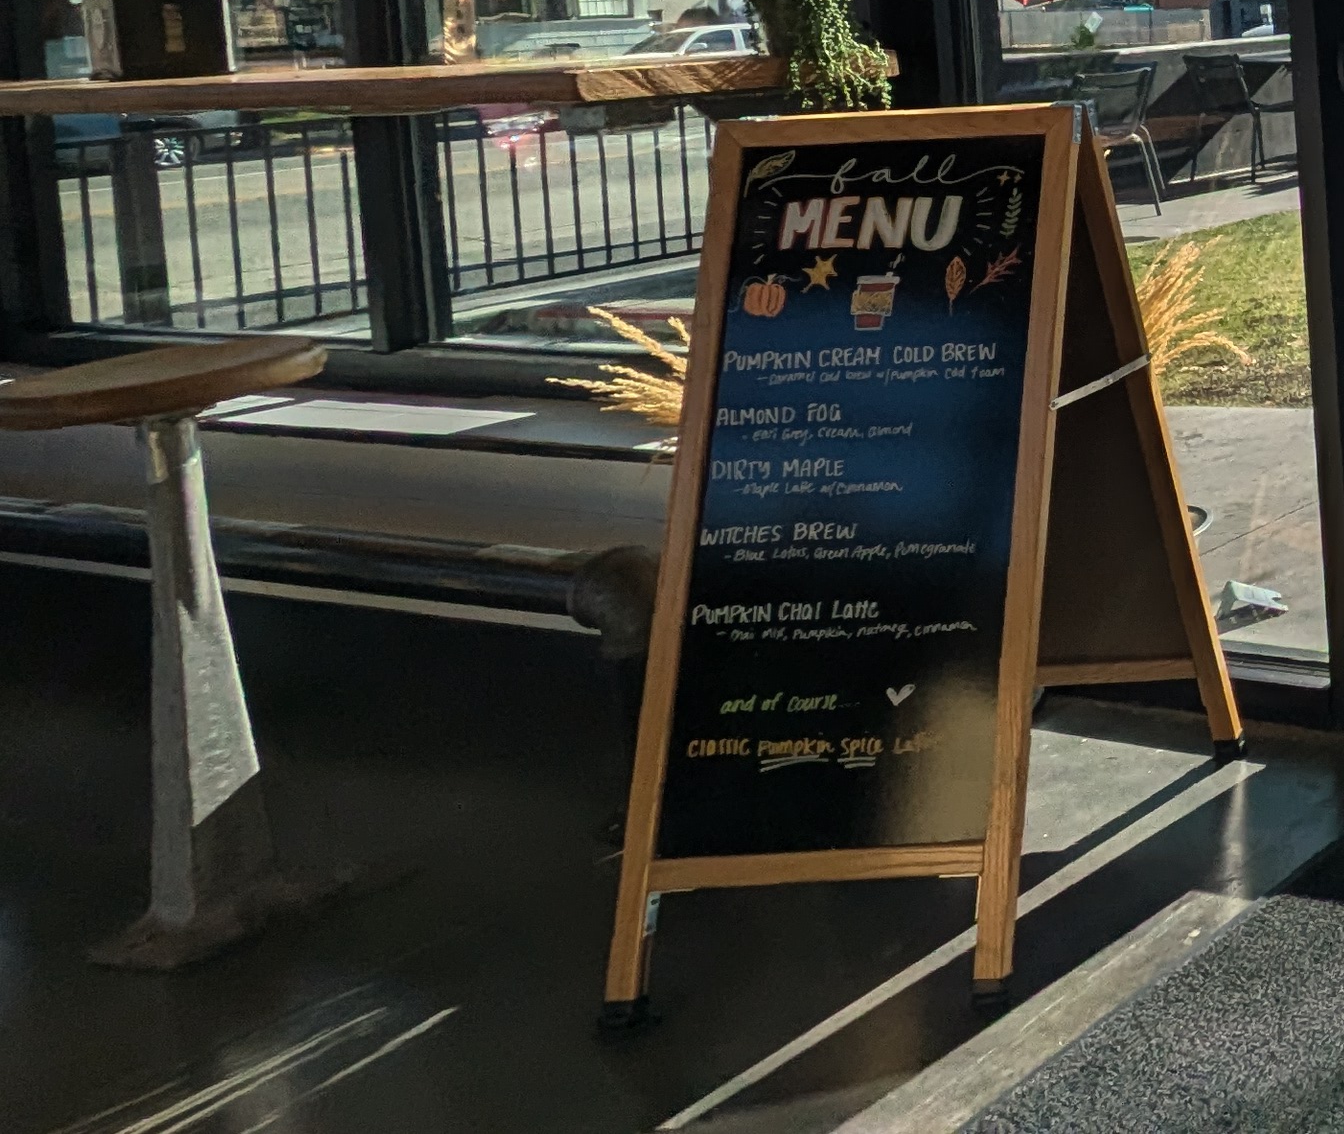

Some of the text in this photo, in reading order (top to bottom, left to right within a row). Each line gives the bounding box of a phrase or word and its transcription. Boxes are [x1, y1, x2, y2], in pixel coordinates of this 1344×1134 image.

[815, 153, 975, 195] fall
[777, 195, 964, 252] MENU
[722, 342, 997, 373] PUMPKIN CREAM COLD BREW
[716, 403, 841, 427] ALMOND FOG
[711, 459, 845, 481] DIRTY MAPLE
[700, 522, 857, 546] WITCHES BREW
[691, 603, 772, 625] PUMPKIN
[720, 694, 755, 715] and
[761, 692, 785, 711] of
